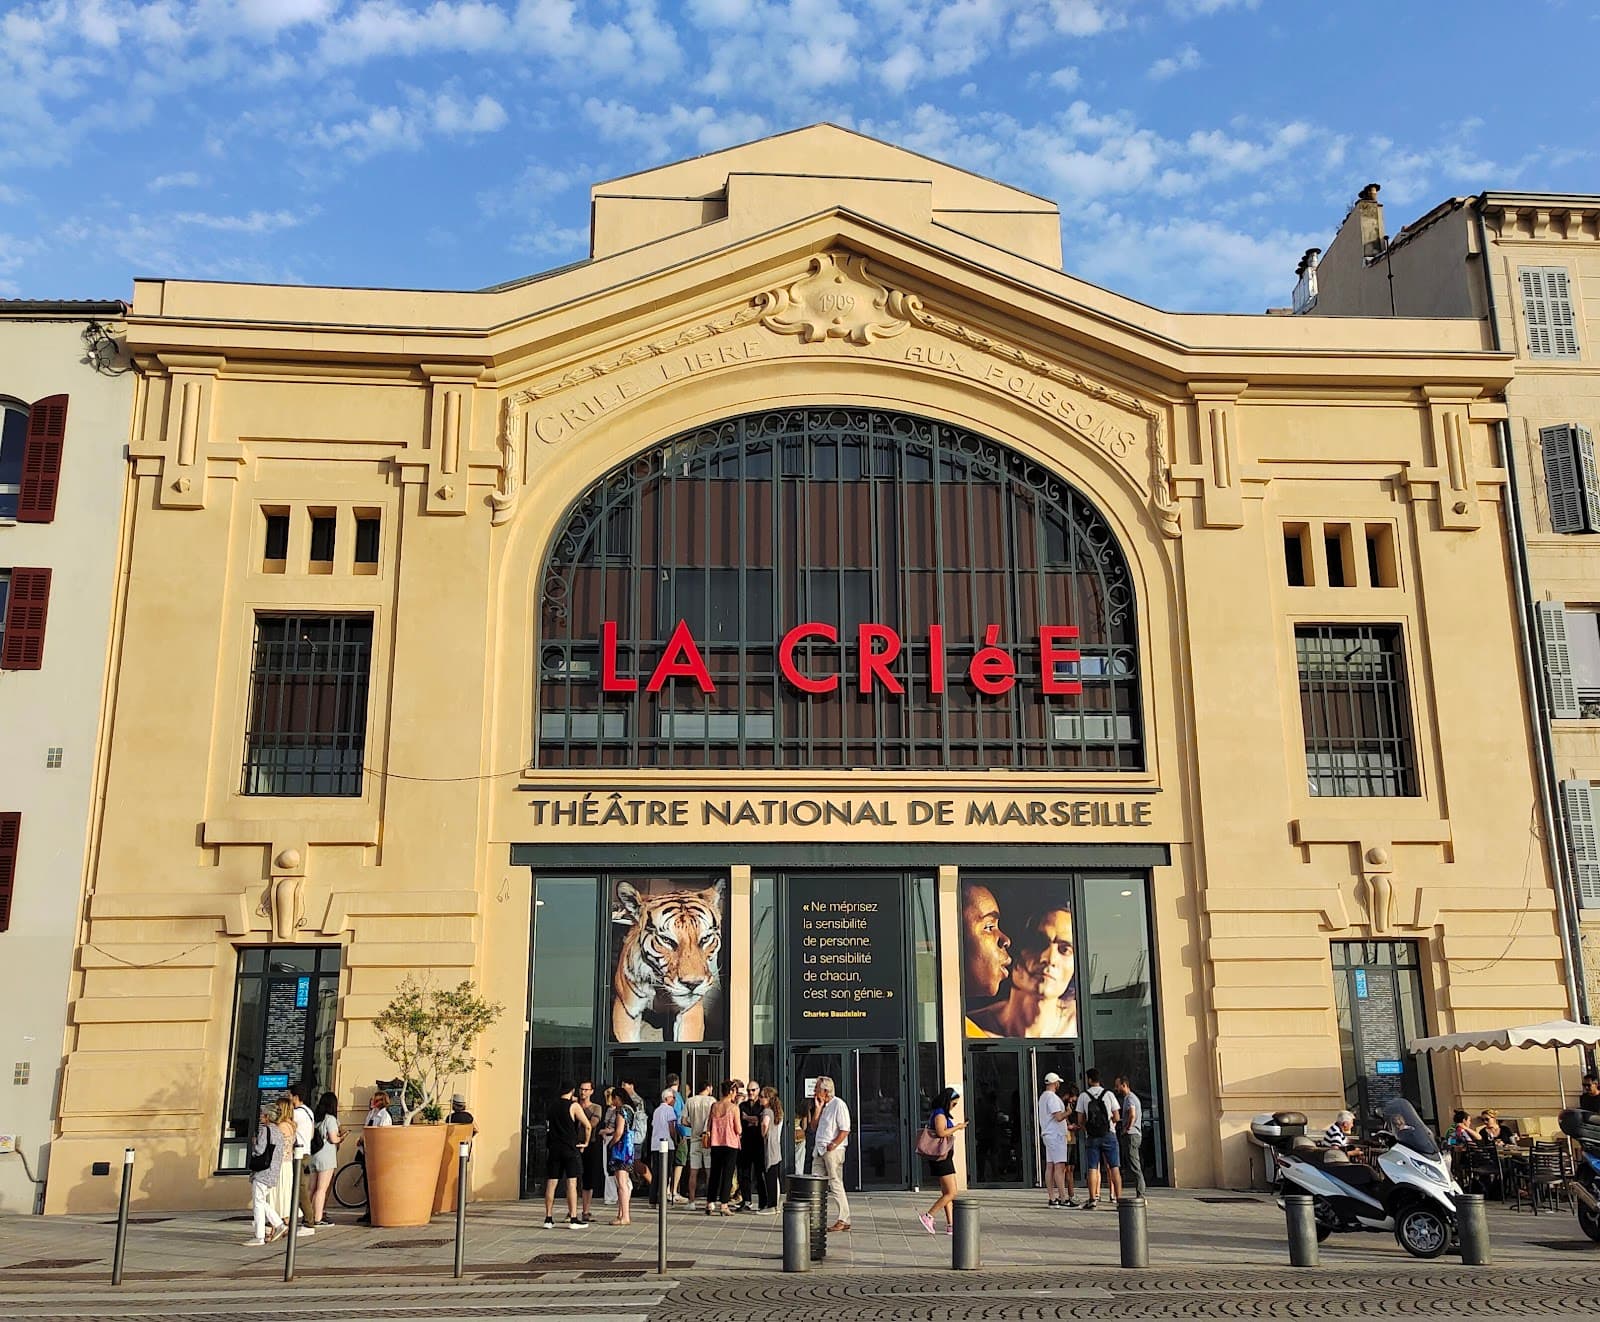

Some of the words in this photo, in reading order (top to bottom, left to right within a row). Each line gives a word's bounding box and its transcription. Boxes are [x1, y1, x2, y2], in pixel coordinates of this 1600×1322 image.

[819, 295, 855, 312] 1909
[535, 381, 641, 444] CRIEE
[660, 341, 762, 380] LIBRE
[905, 346, 964, 372] AUX
[984, 364, 1136, 459] POISSONS
[603, 620, 716, 693] LA
[779, 621, 1082, 695] CRIéE
[530, 791, 689, 826] THÉÂTRE
[702, 799, 897, 826] NATIONAL
[908, 800, 954, 825] DE
[966, 800, 1152, 827] MARSEILLE
[829, 900, 878, 914] méprisez
[803, 918, 812, 929] la
[815, 917, 867, 929] sensibilité
[803, 935, 817, 946] de
[803, 952, 817, 964] La
[819, 952, 871, 964] sensibilité
[803, 969, 817, 981] de
[819, 970, 861, 983] chacun,
[830, 990, 850, 999] son
[803, 1010, 829, 1018] Charles
[830, 1010, 867, 1018] Baudelaire
